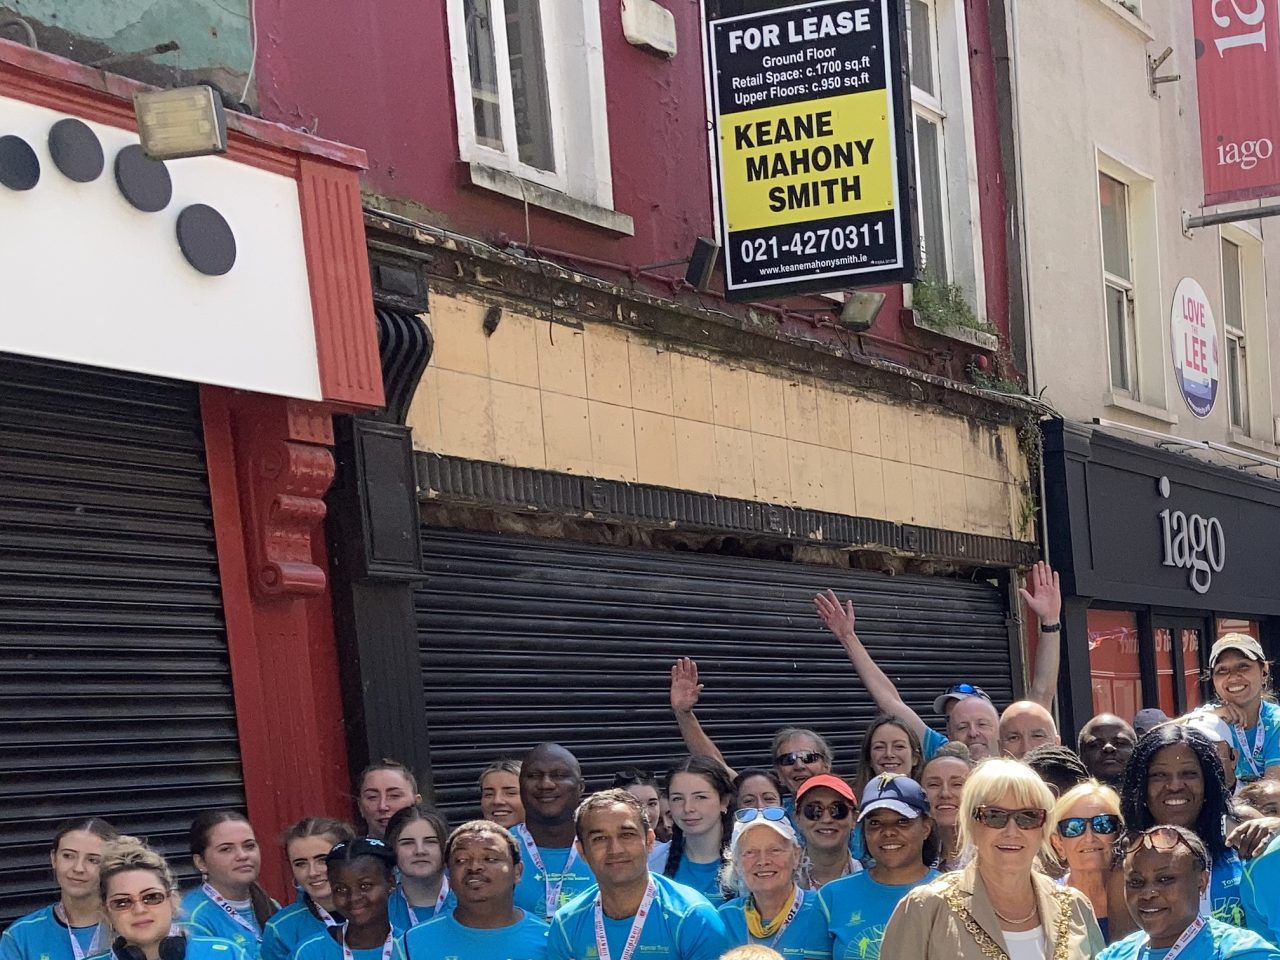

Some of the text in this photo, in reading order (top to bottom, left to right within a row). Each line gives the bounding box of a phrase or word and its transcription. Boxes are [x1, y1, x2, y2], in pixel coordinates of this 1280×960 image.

[728, 8, 871, 53] FOR LEASE
[732, 56, 870, 90] Retail Space: c.1700 sq.ft
[762, 46, 836, 68] Ground Floor
[734, 72, 870, 107] Upper Floors: c.950 sq.ft
[734, 111, 833, 150] KEANE
[746, 138, 875, 182] MAHONY
[1216, 135, 1273, 170] iago
[768, 175, 862, 212] SMITH
[740, 221, 885, 263] 021-4270311
[759, 255, 868, 276] www.keanemahonysmith.ie
[1182, 294, 1206, 328] LOVE
[1184, 332, 1208, 374] LEE
[1159, 476, 1226, 594] iago
[221, 902, 238, 918] 10K
